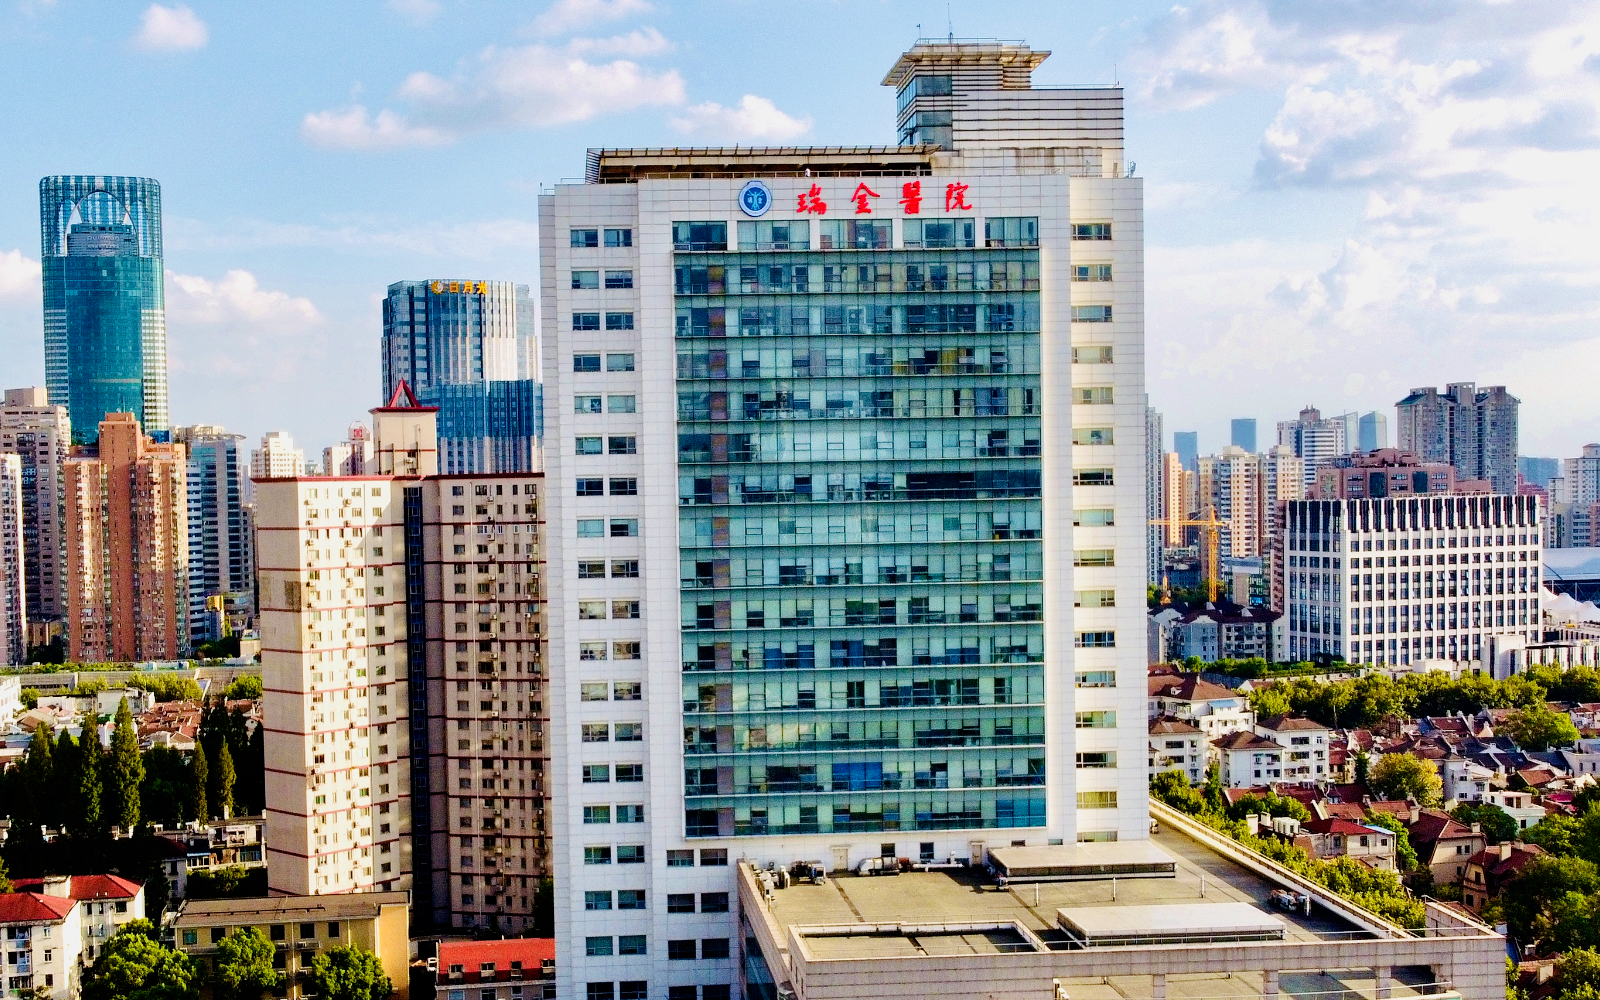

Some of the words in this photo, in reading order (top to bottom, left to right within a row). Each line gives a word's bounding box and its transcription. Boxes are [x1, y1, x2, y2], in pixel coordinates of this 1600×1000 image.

[796, 180, 973, 215] 瑞金醫院
[449, 281, 488, 295] 日月光
